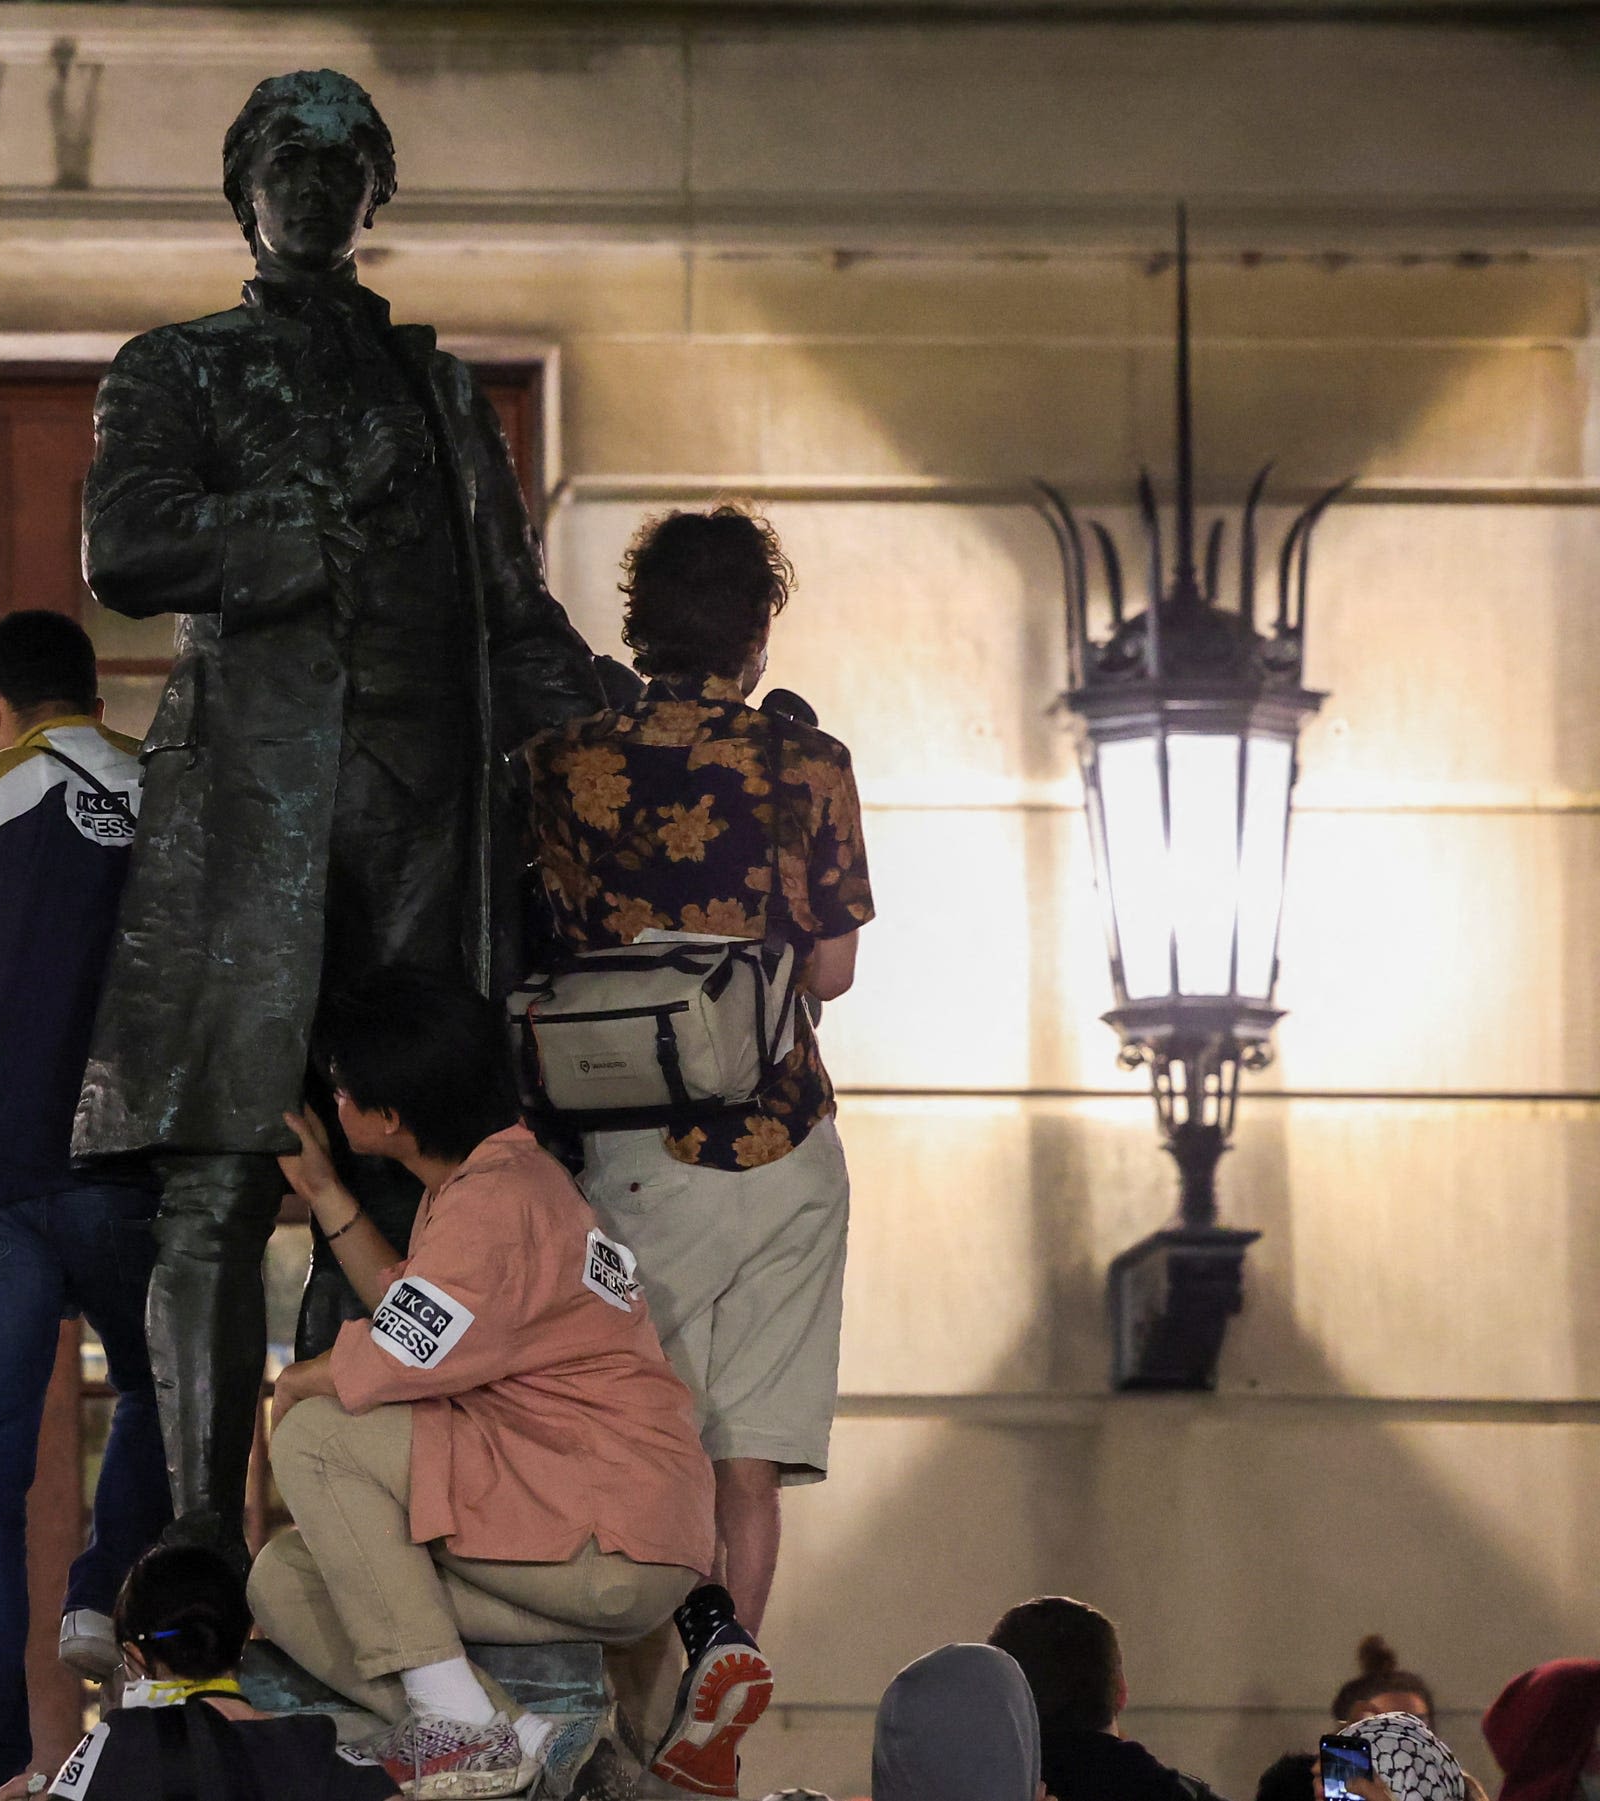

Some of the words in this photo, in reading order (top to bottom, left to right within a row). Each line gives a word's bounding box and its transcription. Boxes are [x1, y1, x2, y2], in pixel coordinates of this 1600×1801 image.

[79, 813, 136, 838] ESS
[395, 1288, 447, 1333] WKCR
[374, 1308, 435, 1360] PRESS
